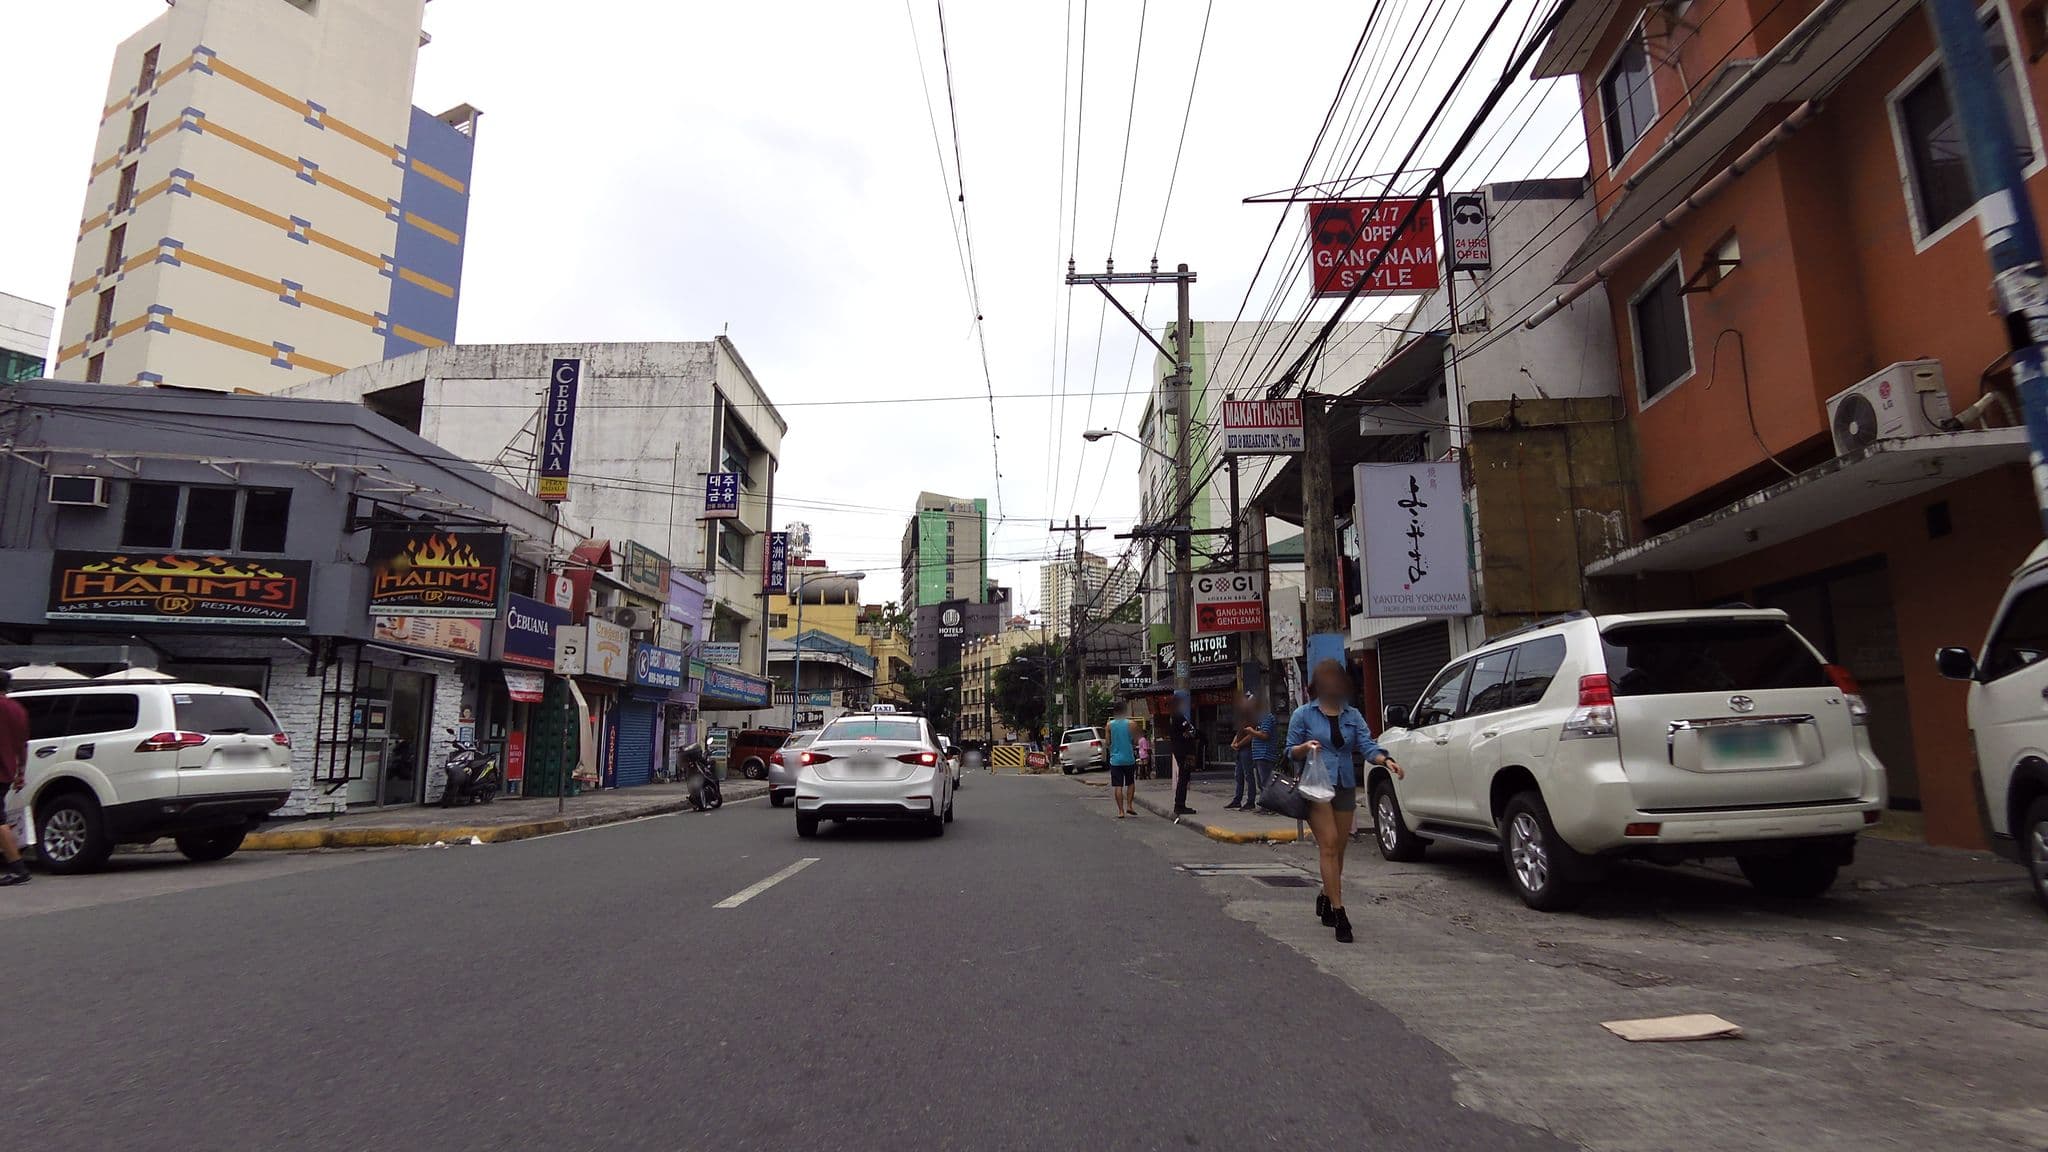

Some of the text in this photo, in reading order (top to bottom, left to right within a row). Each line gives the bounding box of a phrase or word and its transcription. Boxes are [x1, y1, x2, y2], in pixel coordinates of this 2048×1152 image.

[1361, 207, 1399, 221] 24/7
[1362, 226, 1403, 242] OPEN
[1455, 238, 1487, 248] 24 HRS
[1317, 247, 1433, 268] GANGNAM
[1457, 250, 1488, 260] OPEN
[1341, 268, 1413, 287] STYLE
[1883, 400, 1894, 410] LG
[549, 363, 574, 471] CEBUANA
[1225, 402, 1300, 427] MAKATI HOSTEL
[1228, 434, 1238, 448] BED
[1243, 434, 1270, 448] BREAKFAST
[73, 574, 286, 600] HALIM'S
[381, 570, 489, 589] HALIM'S
[1373, 593, 1467, 603] YAKITORI YOKOYAMA
[58, 603, 88, 612] BAR
[201, 601, 289, 619] RESTAURANT
[507, 606, 549, 636] CEBUANA
[1217, 616, 1262, 625] GENTLEMAN
